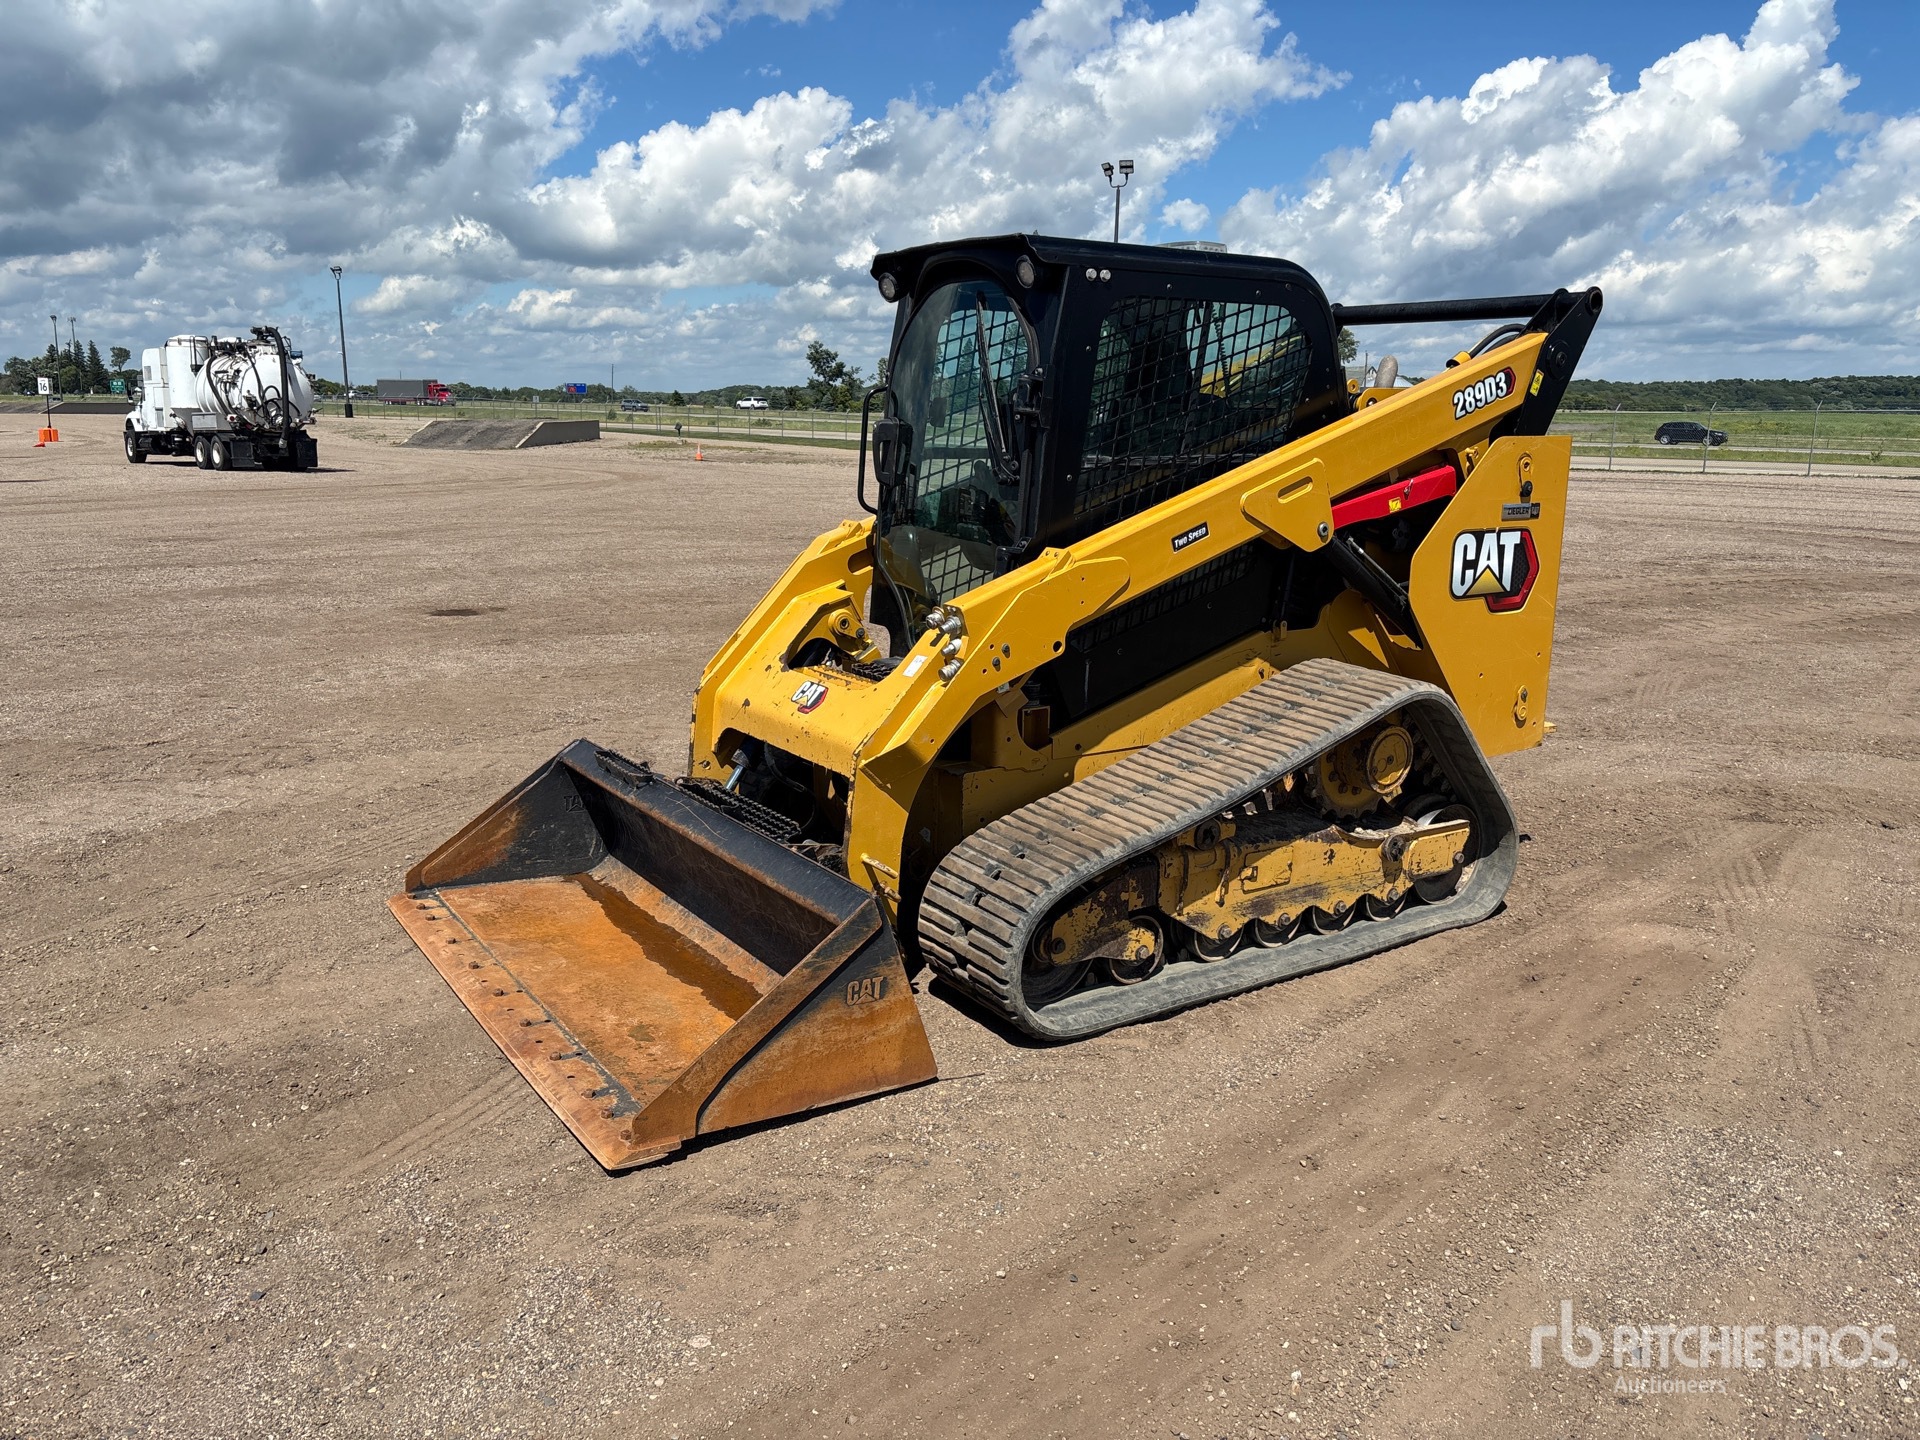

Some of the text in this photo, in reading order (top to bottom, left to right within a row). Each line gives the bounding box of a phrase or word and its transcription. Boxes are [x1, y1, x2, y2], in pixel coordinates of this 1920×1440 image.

[39, 382, 48, 392] 16
[1453, 371, 1508, 419] 289D3
[1452, 531, 1521, 597] CAT
[791, 680, 826, 707] CAT
[847, 976, 884, 1006] CAT
